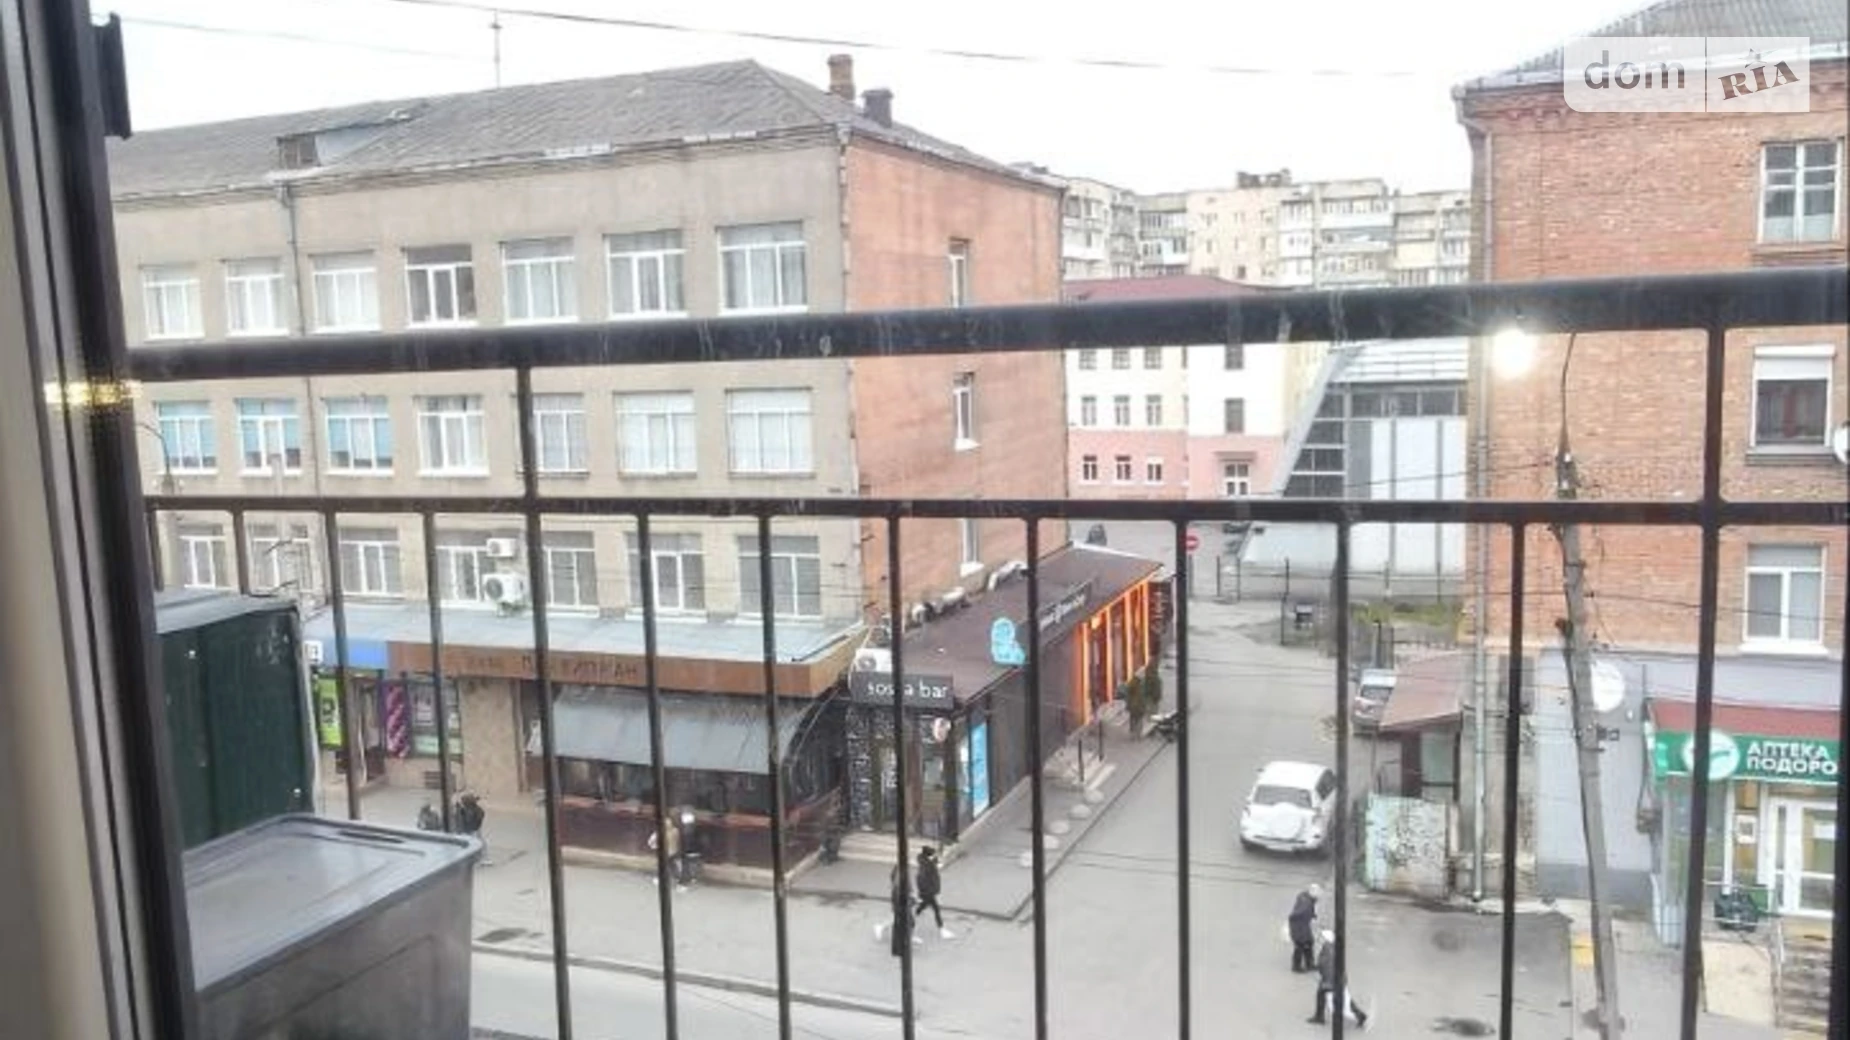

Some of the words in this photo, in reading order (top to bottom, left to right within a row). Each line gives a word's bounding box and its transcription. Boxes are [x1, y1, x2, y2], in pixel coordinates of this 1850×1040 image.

[867, 682, 914, 697] sosa
[919, 679, 949, 698] bar
[1747, 741, 1830, 759] АПТЕКА
